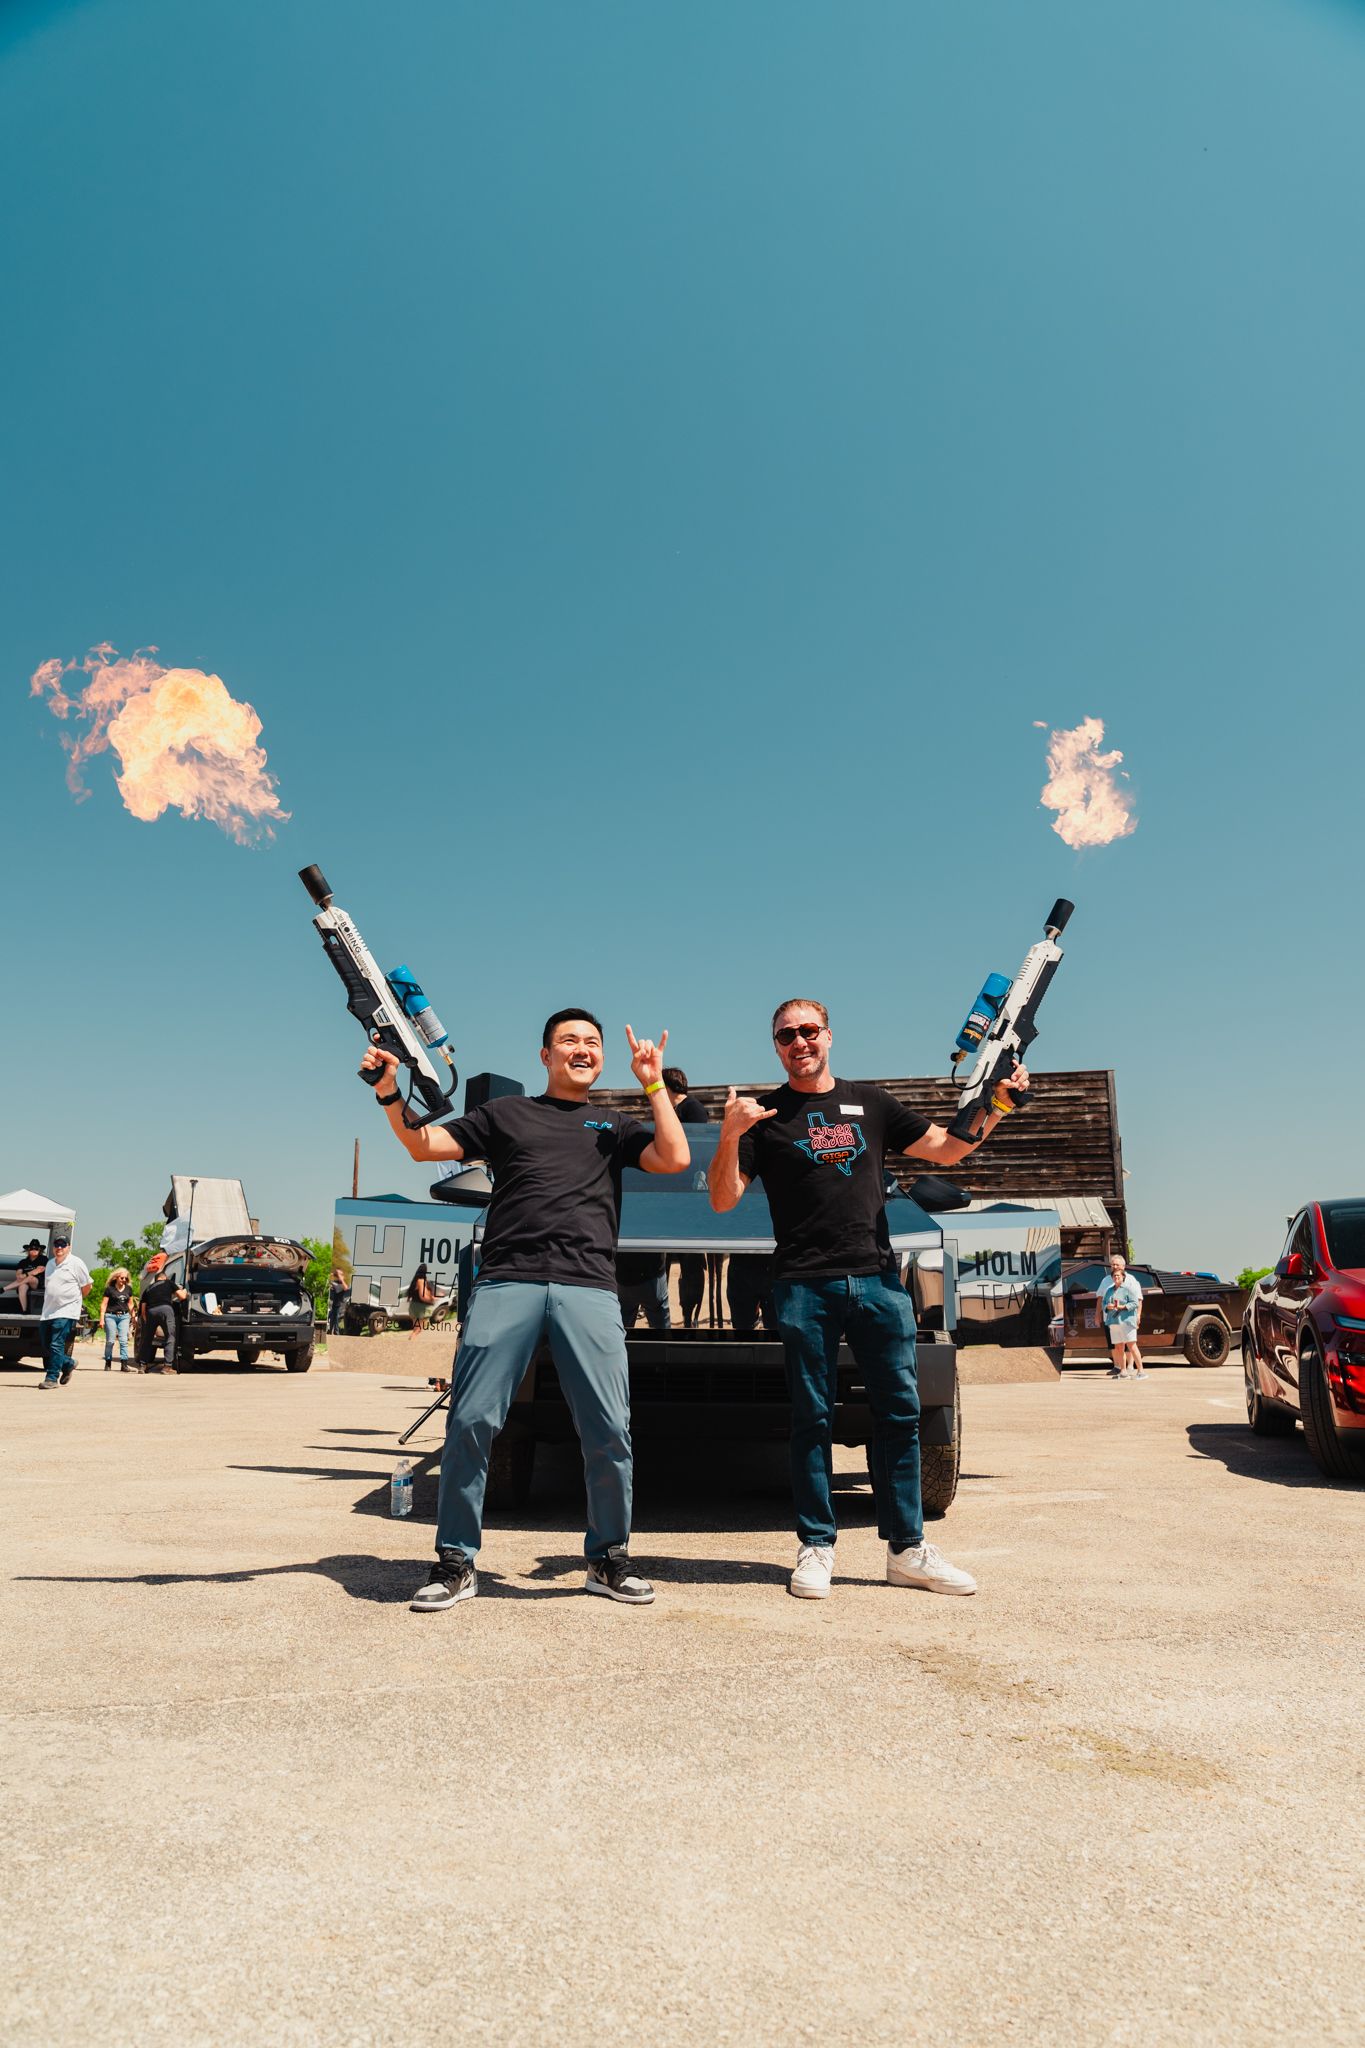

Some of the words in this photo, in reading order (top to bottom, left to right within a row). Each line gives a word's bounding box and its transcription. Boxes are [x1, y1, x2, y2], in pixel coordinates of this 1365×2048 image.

[821, 1151, 849, 1160] GIGA
[419, 1237, 473, 1265] HOL
[975, 1250, 1037, 1276] HOLM
